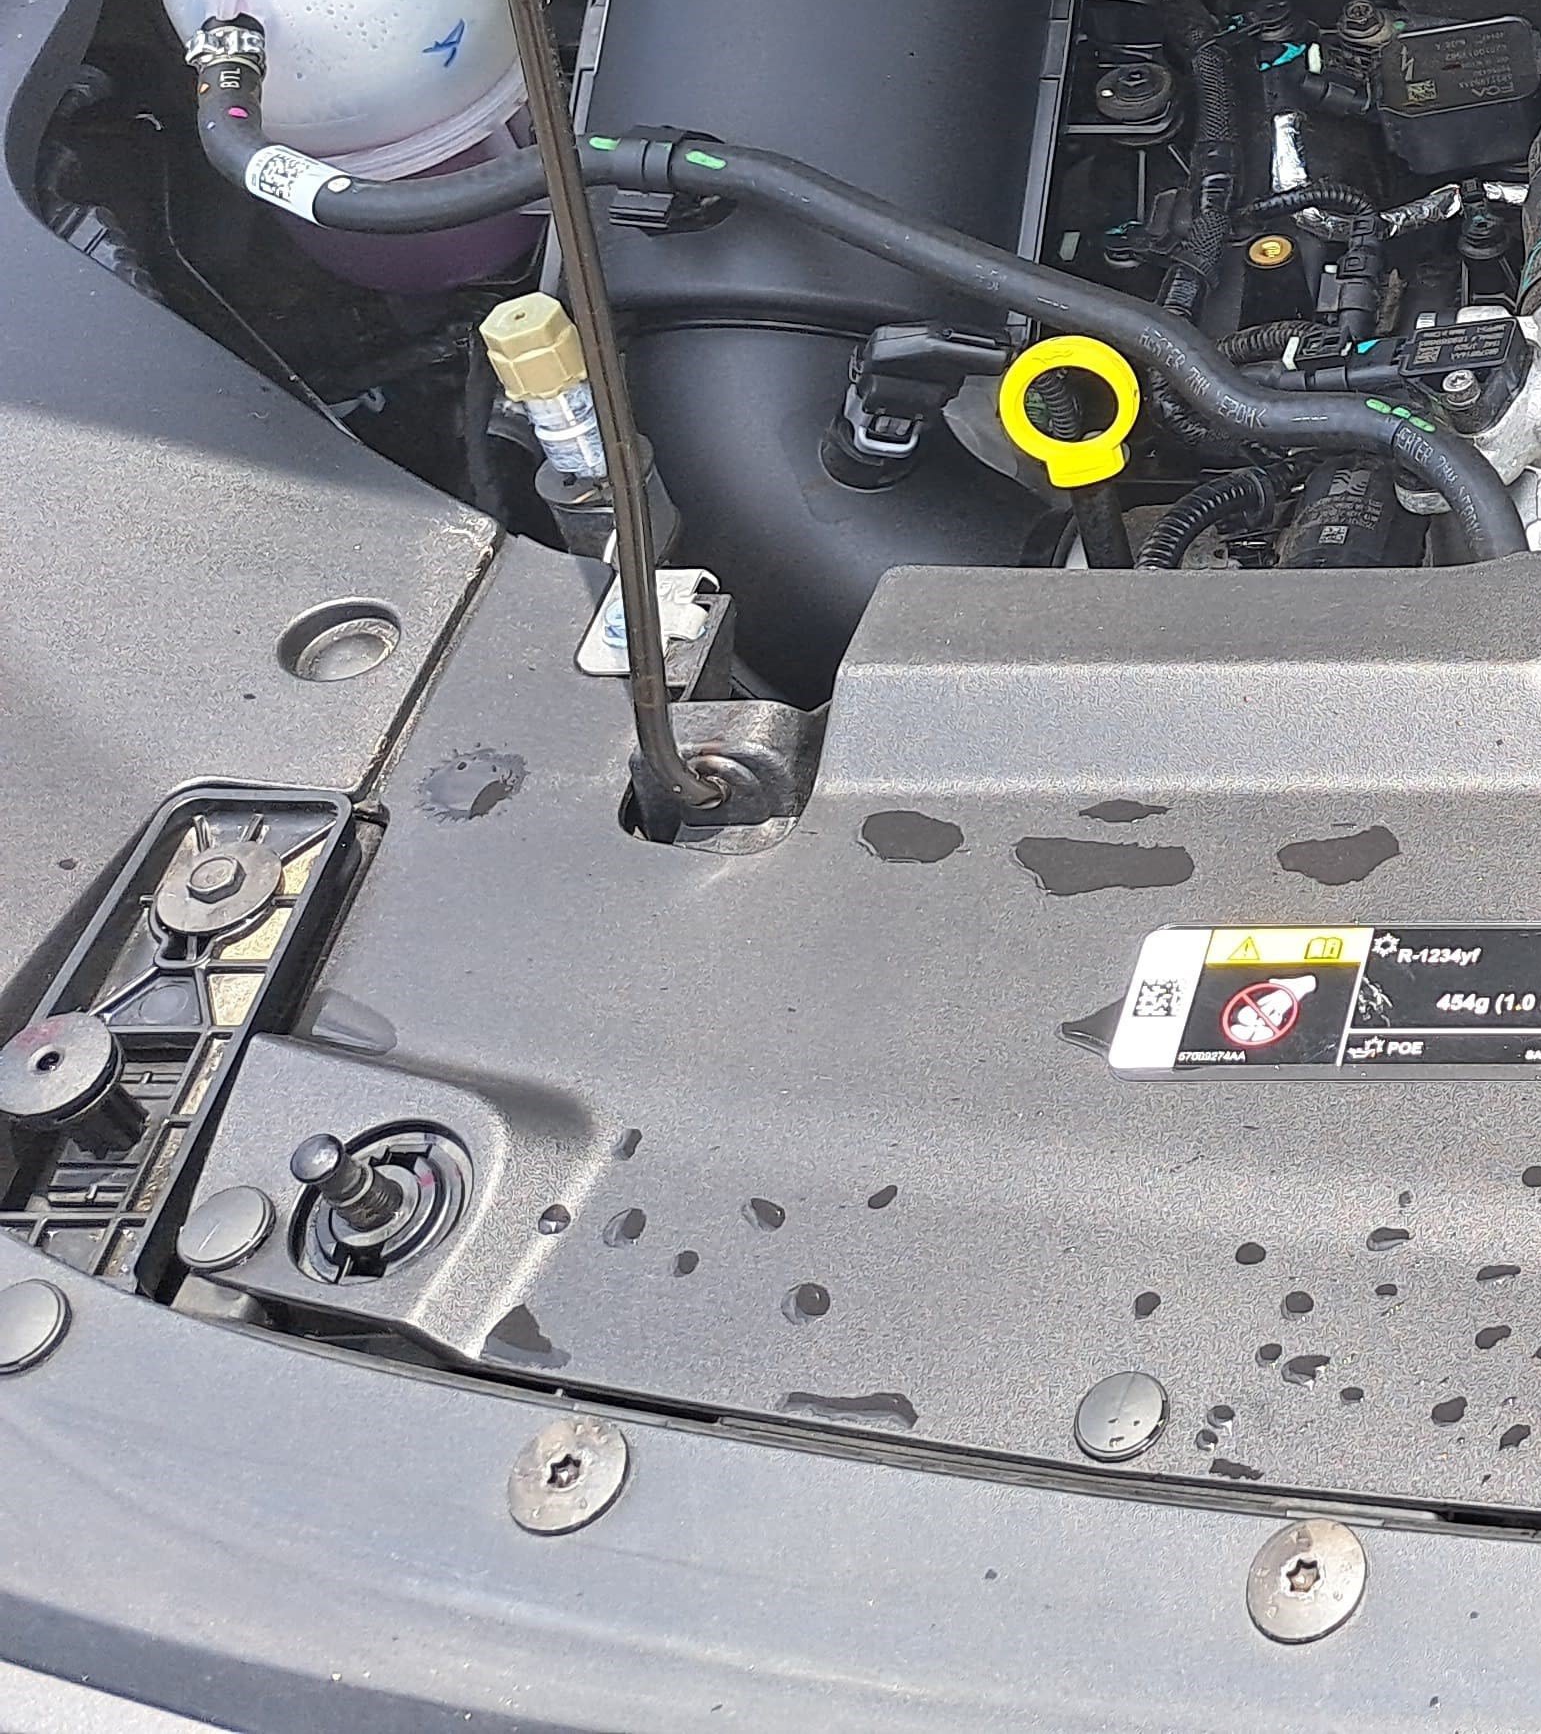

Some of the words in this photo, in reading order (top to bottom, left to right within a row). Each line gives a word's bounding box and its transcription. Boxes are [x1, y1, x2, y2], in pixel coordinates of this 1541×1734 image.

[219, 67, 241, 90] BTL
[1396, 946, 1482, 967] R-1234yf
[1435, 993, 1490, 1016] 454g
[1493, 992, 1537, 1016] (1.0
[1386, 1041, 1425, 1056] POE
